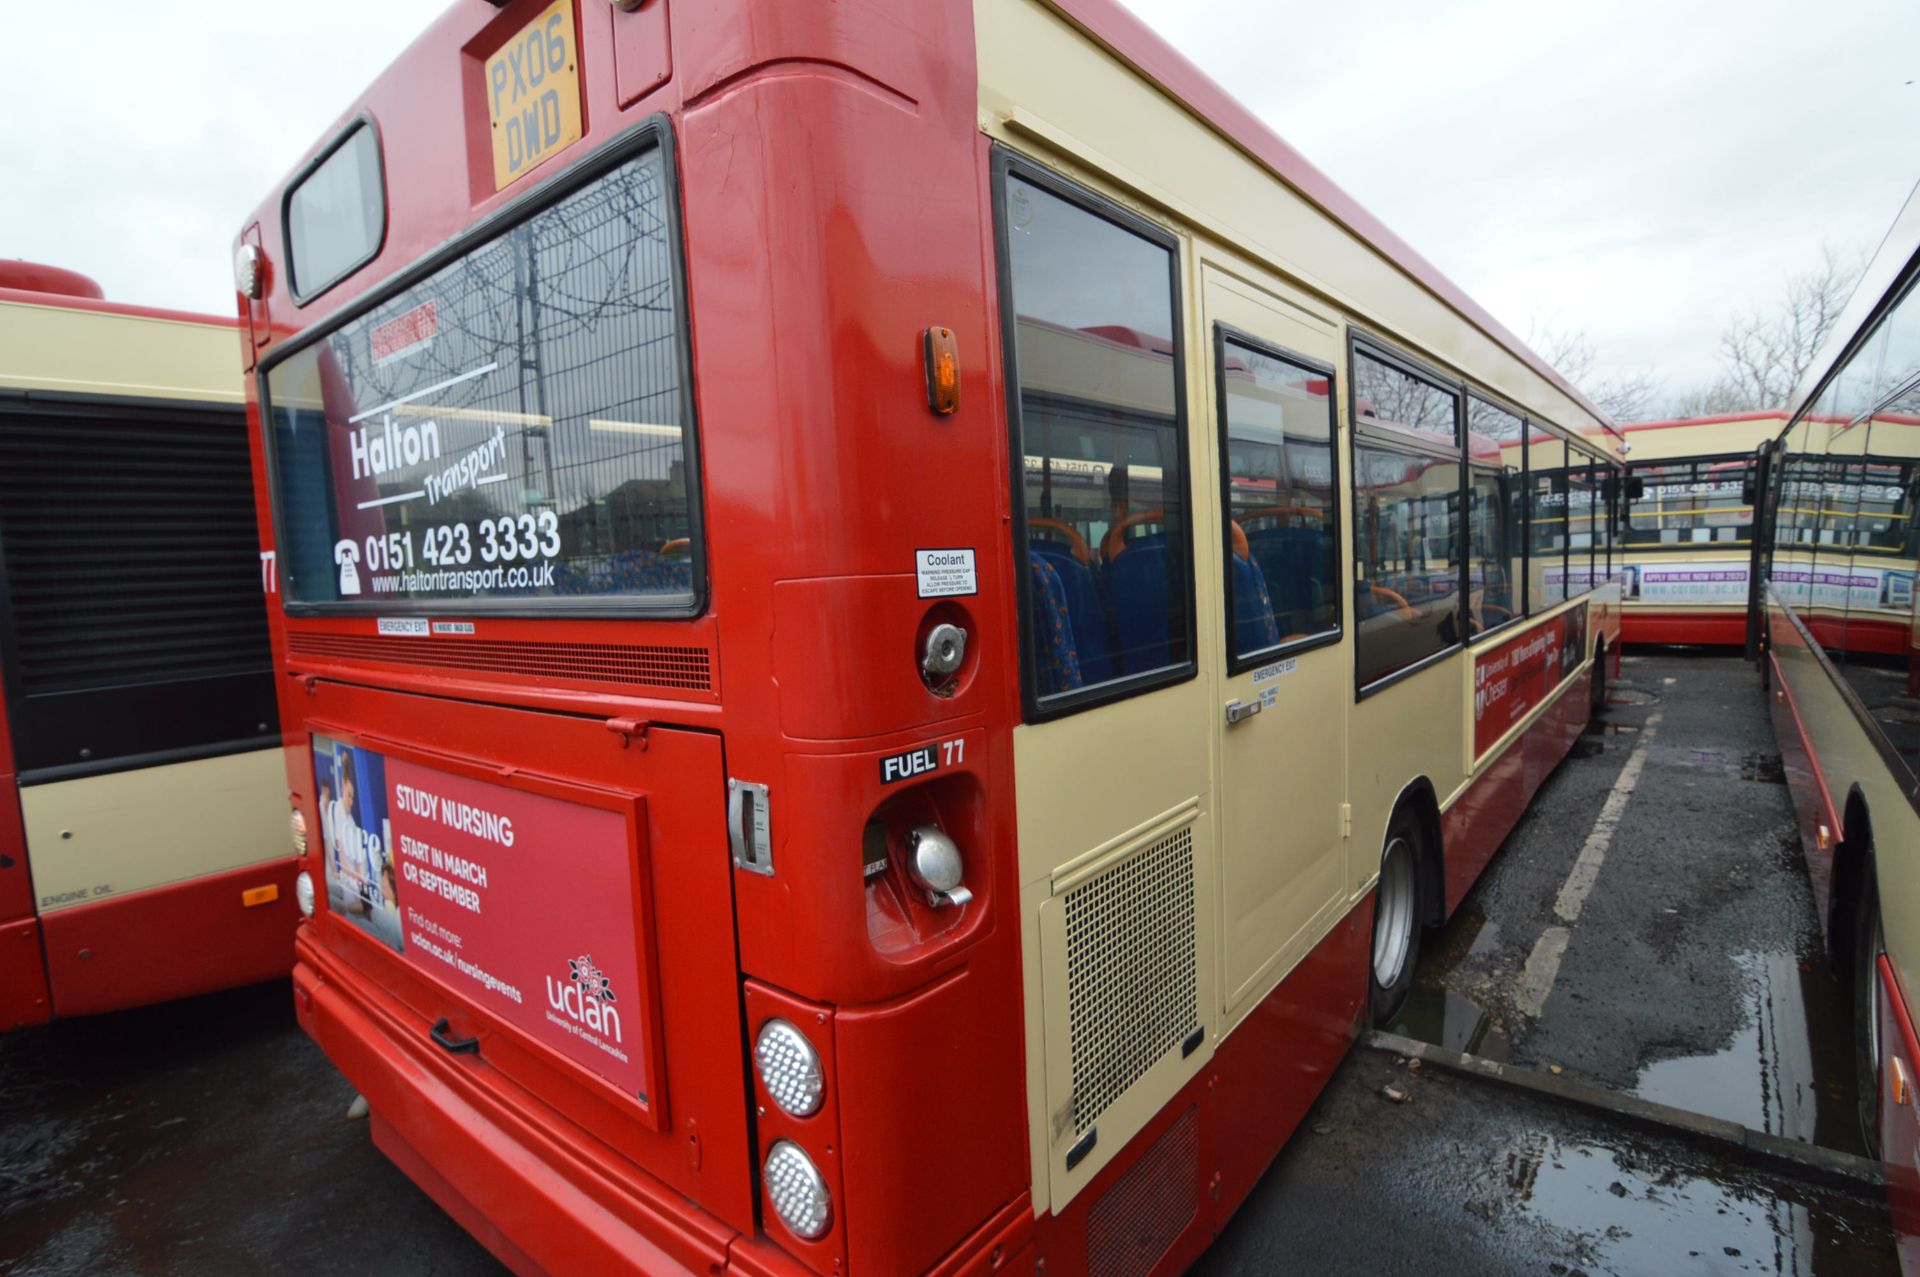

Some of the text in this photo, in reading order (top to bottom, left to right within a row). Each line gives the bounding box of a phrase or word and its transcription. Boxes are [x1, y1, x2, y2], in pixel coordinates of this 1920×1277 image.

[492, 12, 566, 117] PX06
[506, 88, 561, 173] DWD
[350, 414, 440, 480] Halton
[424, 425, 506, 506] Transport
[365, 510, 561, 571] 0151 423 3333
[927, 553, 965, 566] Coolant
[372, 559, 555, 594] www.haltontransport.co.uk
[1254, 658, 1296, 682] EMERGENCY EXIT
[884, 738, 965, 781] FUEL 77
[396, 784, 514, 847] STUDY NURSING
[400, 834, 488, 888] START IN MARCH
[403, 861, 419, 884] OR
[419, 868, 481, 914] SEPTEMBER
[41, 884, 114, 908] ENGINE OIL
[408, 906, 463, 949] Find out more:
[546, 975, 622, 1043] uclan
[546, 1010, 628, 1063] University of Central Lancashire
